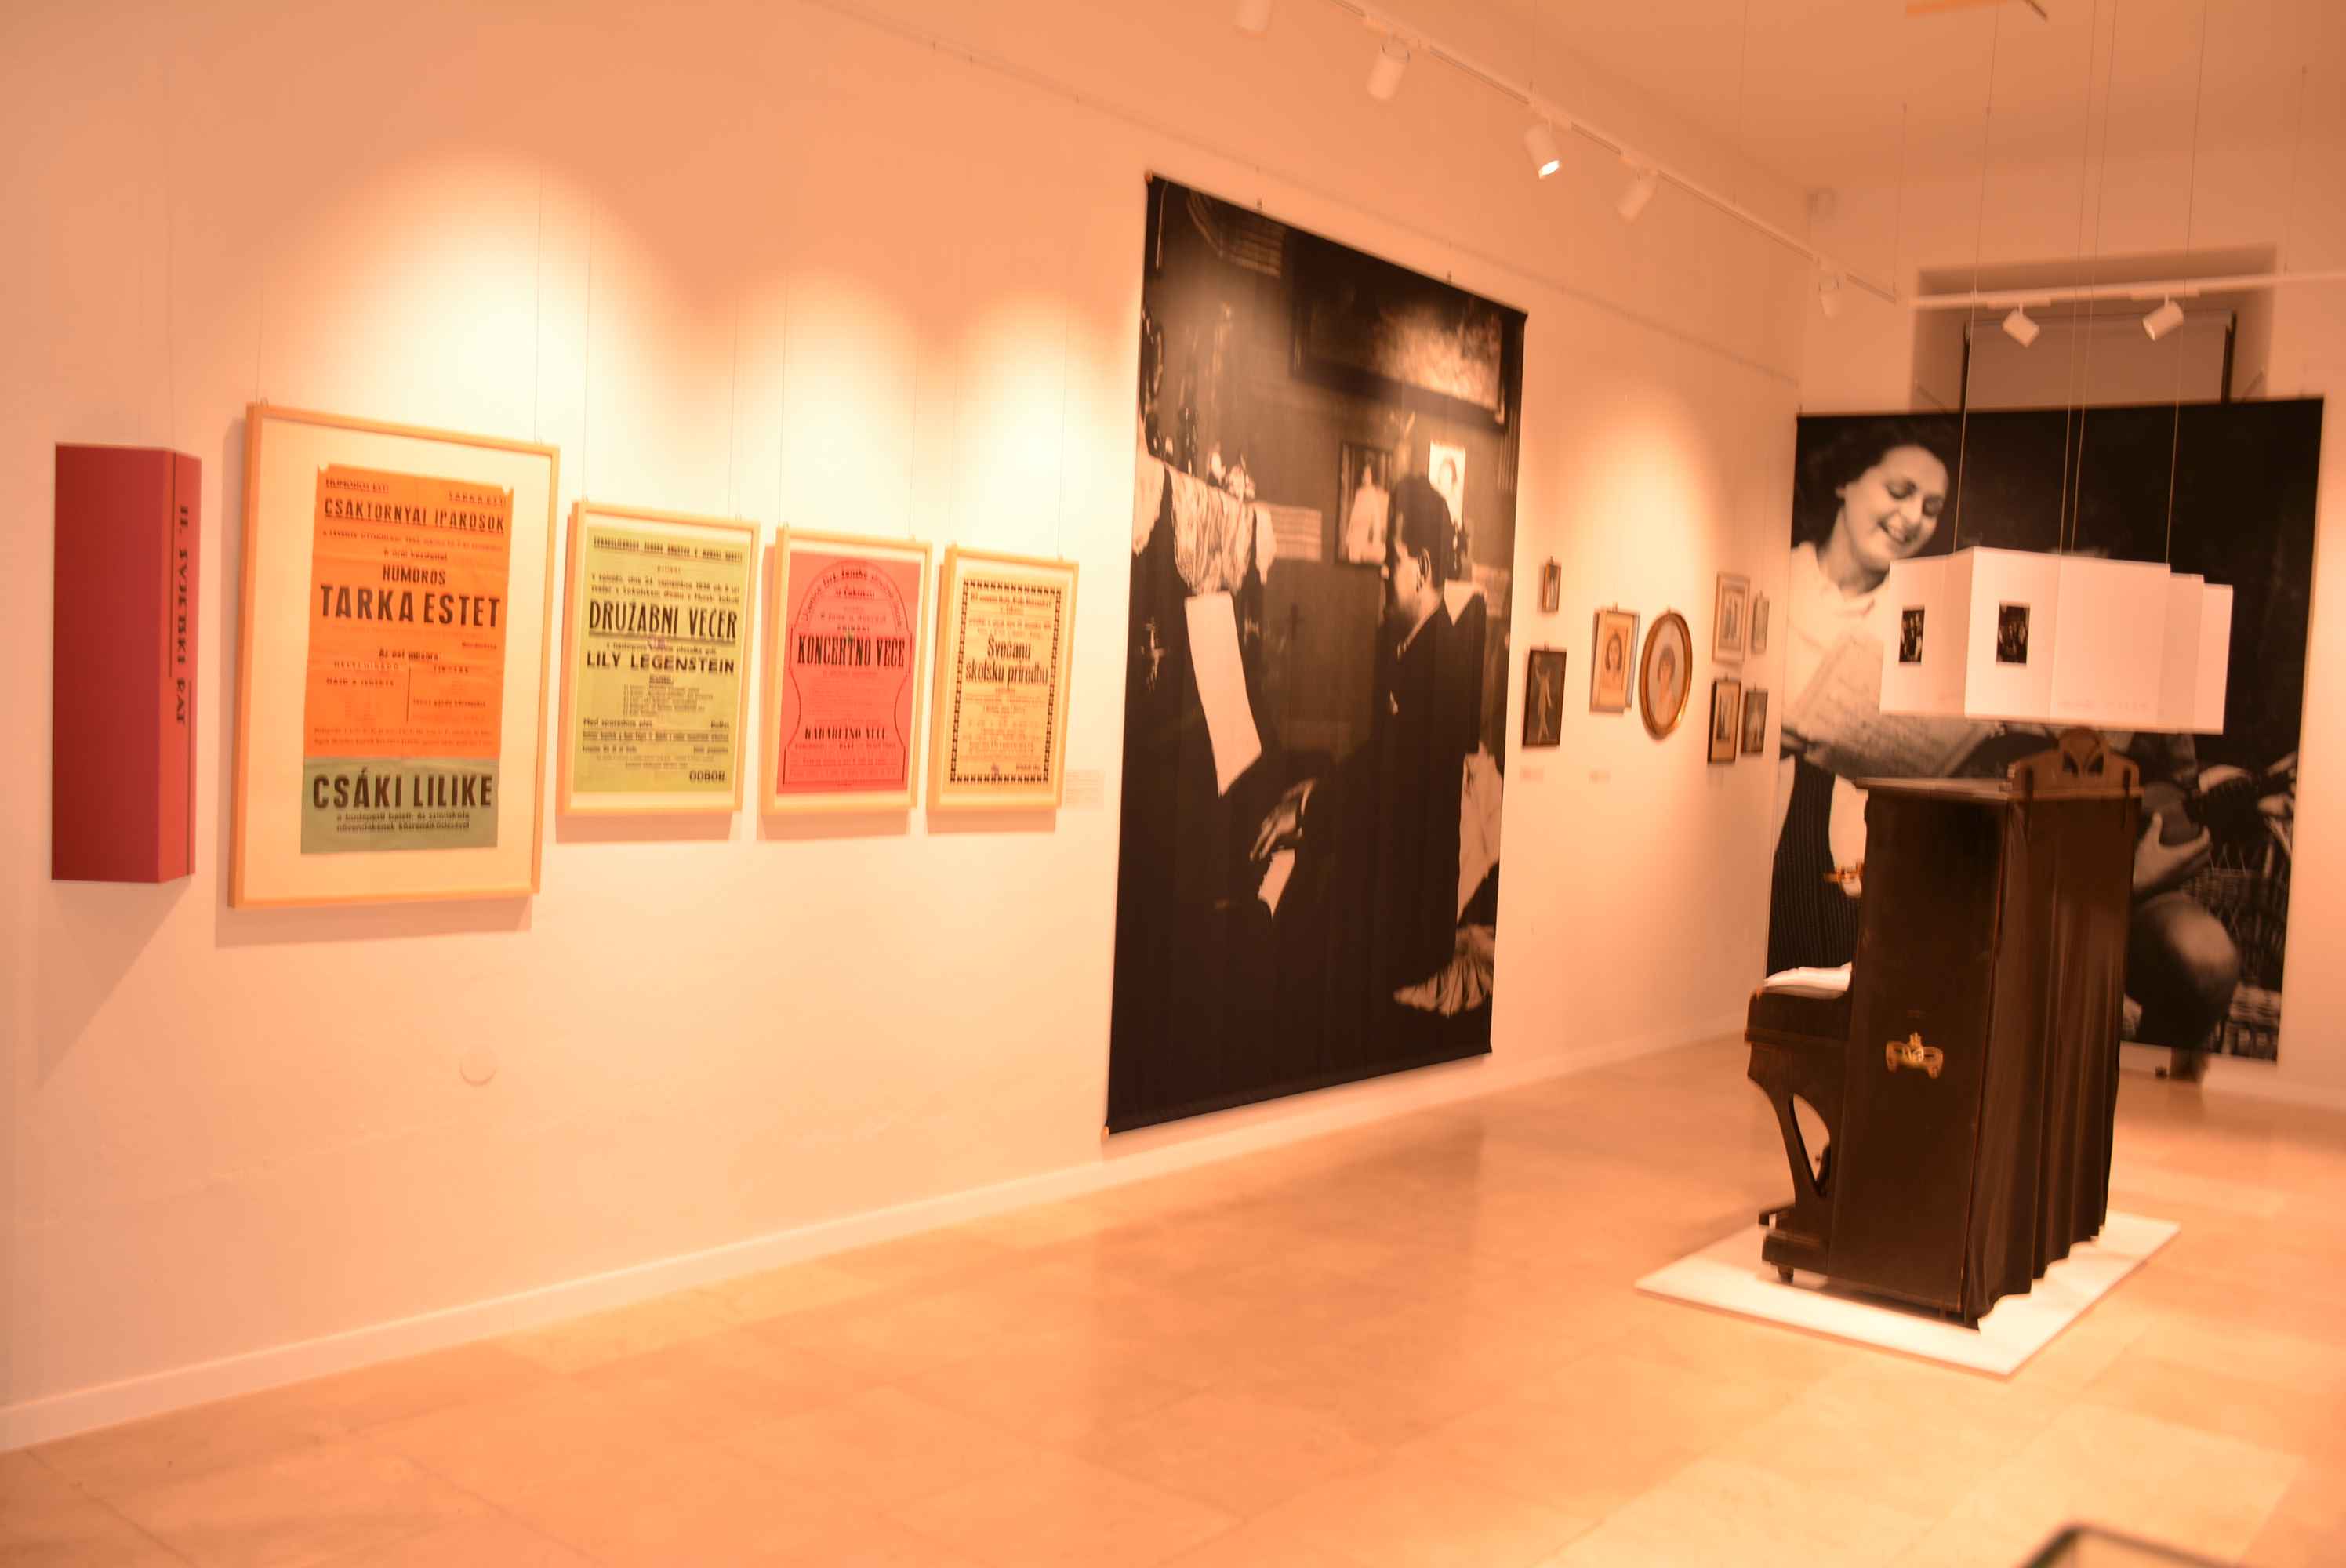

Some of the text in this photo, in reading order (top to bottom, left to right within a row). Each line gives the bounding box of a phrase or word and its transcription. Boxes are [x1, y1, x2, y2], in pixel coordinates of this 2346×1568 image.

[434, 507, 505, 533] IPAROSOK
[383, 564, 447, 585] HUMOROS
[320, 583, 501, 627] TARKA ESTET
[586, 651, 735, 674] LILY LEGENSTEIN
[797, 635, 872, 666] KONCERTNO
[313, 766, 493, 809] CSÁKI LILIKE
